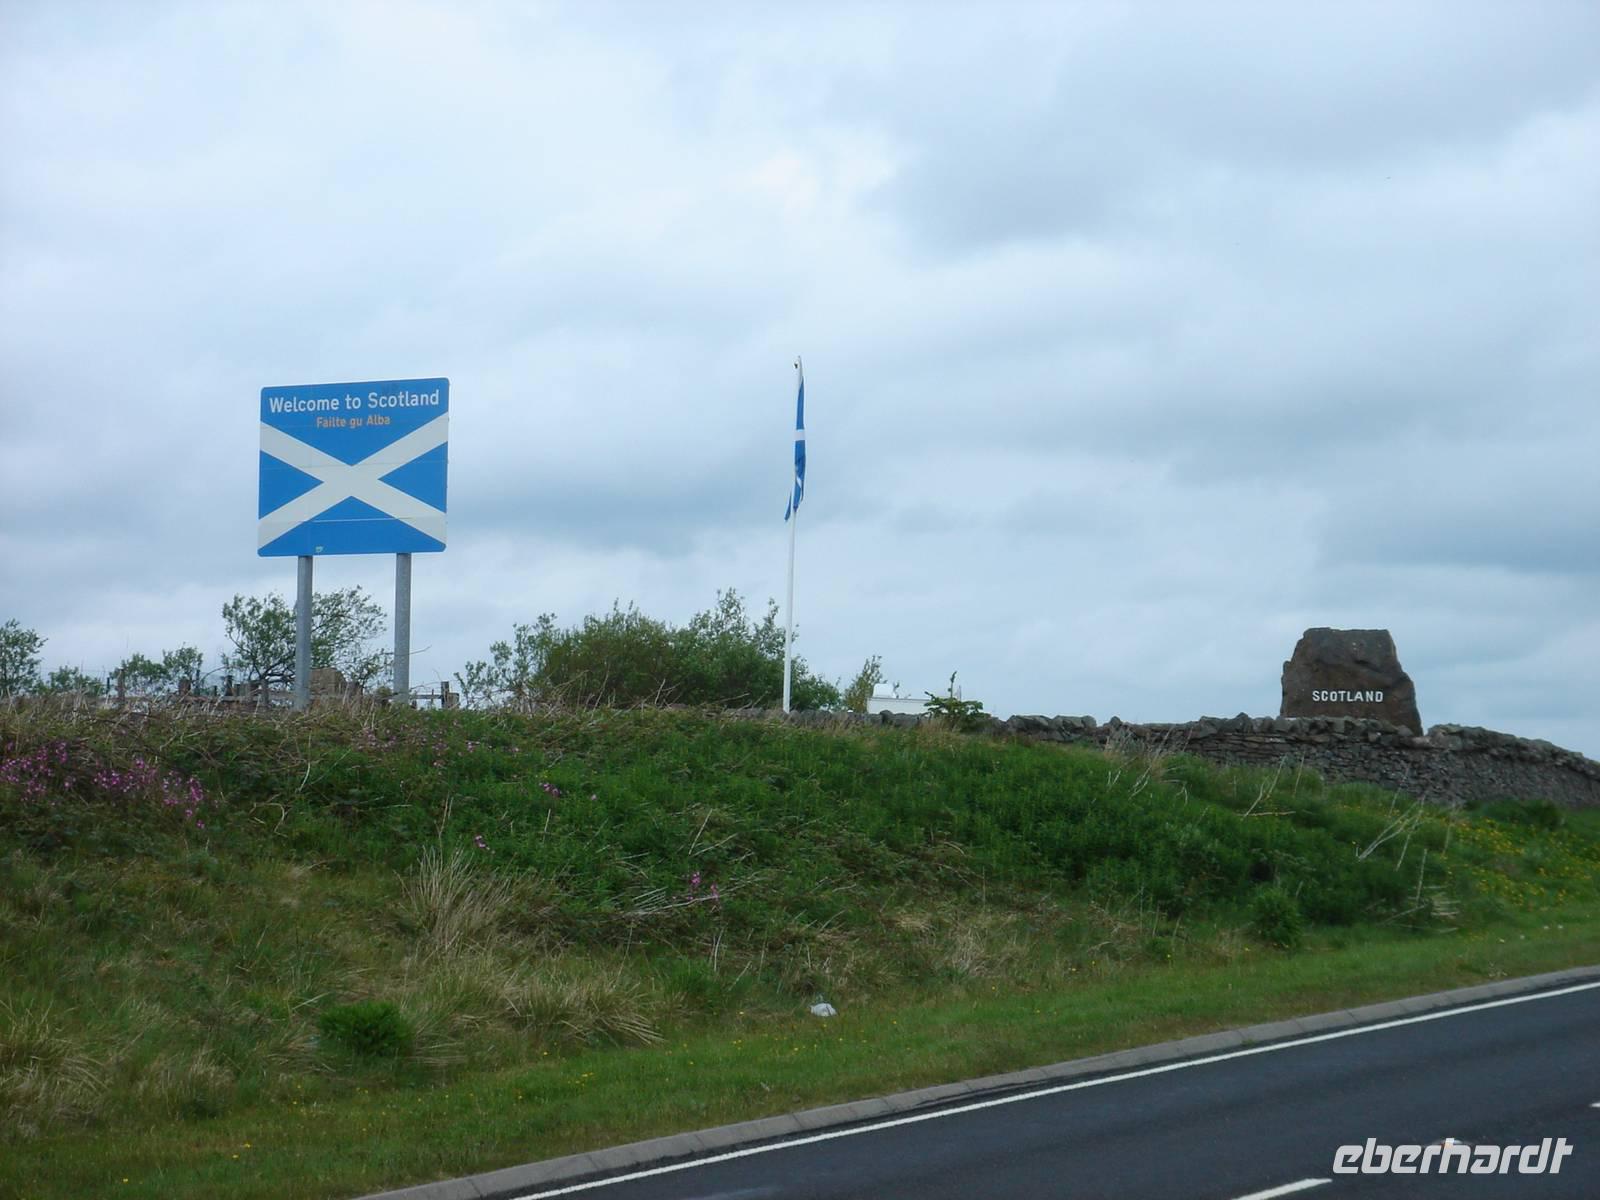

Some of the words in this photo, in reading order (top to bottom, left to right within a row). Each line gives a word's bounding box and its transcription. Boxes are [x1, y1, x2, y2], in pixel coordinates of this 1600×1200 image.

[269, 397, 340, 413] Welcome
[345, 394, 362, 409] to
[367, 390, 440, 408] Scotland
[349, 417, 363, 429] gu
[366, 415, 391, 426] Alba
[1312, 690, 1383, 703] SCOTLAND
